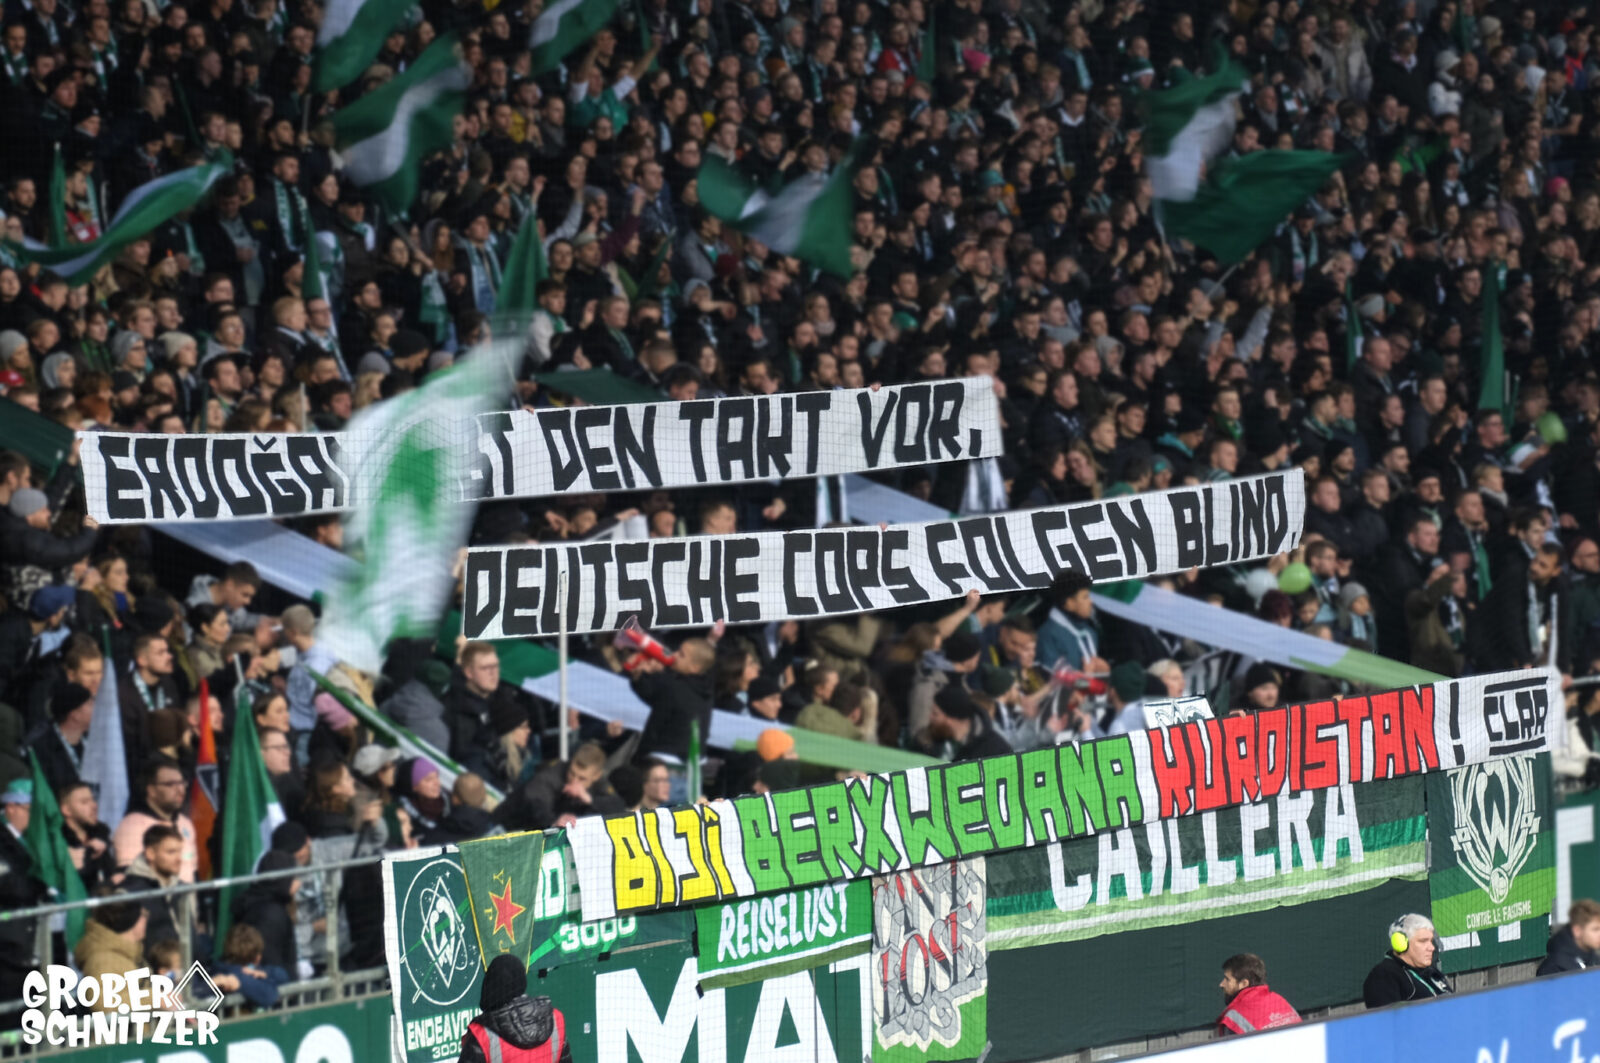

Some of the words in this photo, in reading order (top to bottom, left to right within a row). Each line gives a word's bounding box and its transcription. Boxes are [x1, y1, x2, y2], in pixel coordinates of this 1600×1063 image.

[98, 435, 345, 520] ERDOĞA
[536, 405, 663, 492] DEN
[679, 392, 831, 483] TAKT
[856, 382, 983, 468] VOR,
[464, 537, 761, 638] DEUTSCHE
[783, 530, 931, 616] COPS
[925, 498, 1158, 595] FOLGEN
[733, 738, 1142, 895] BERXWEDANA
[717, 882, 850, 963] REISELUST
